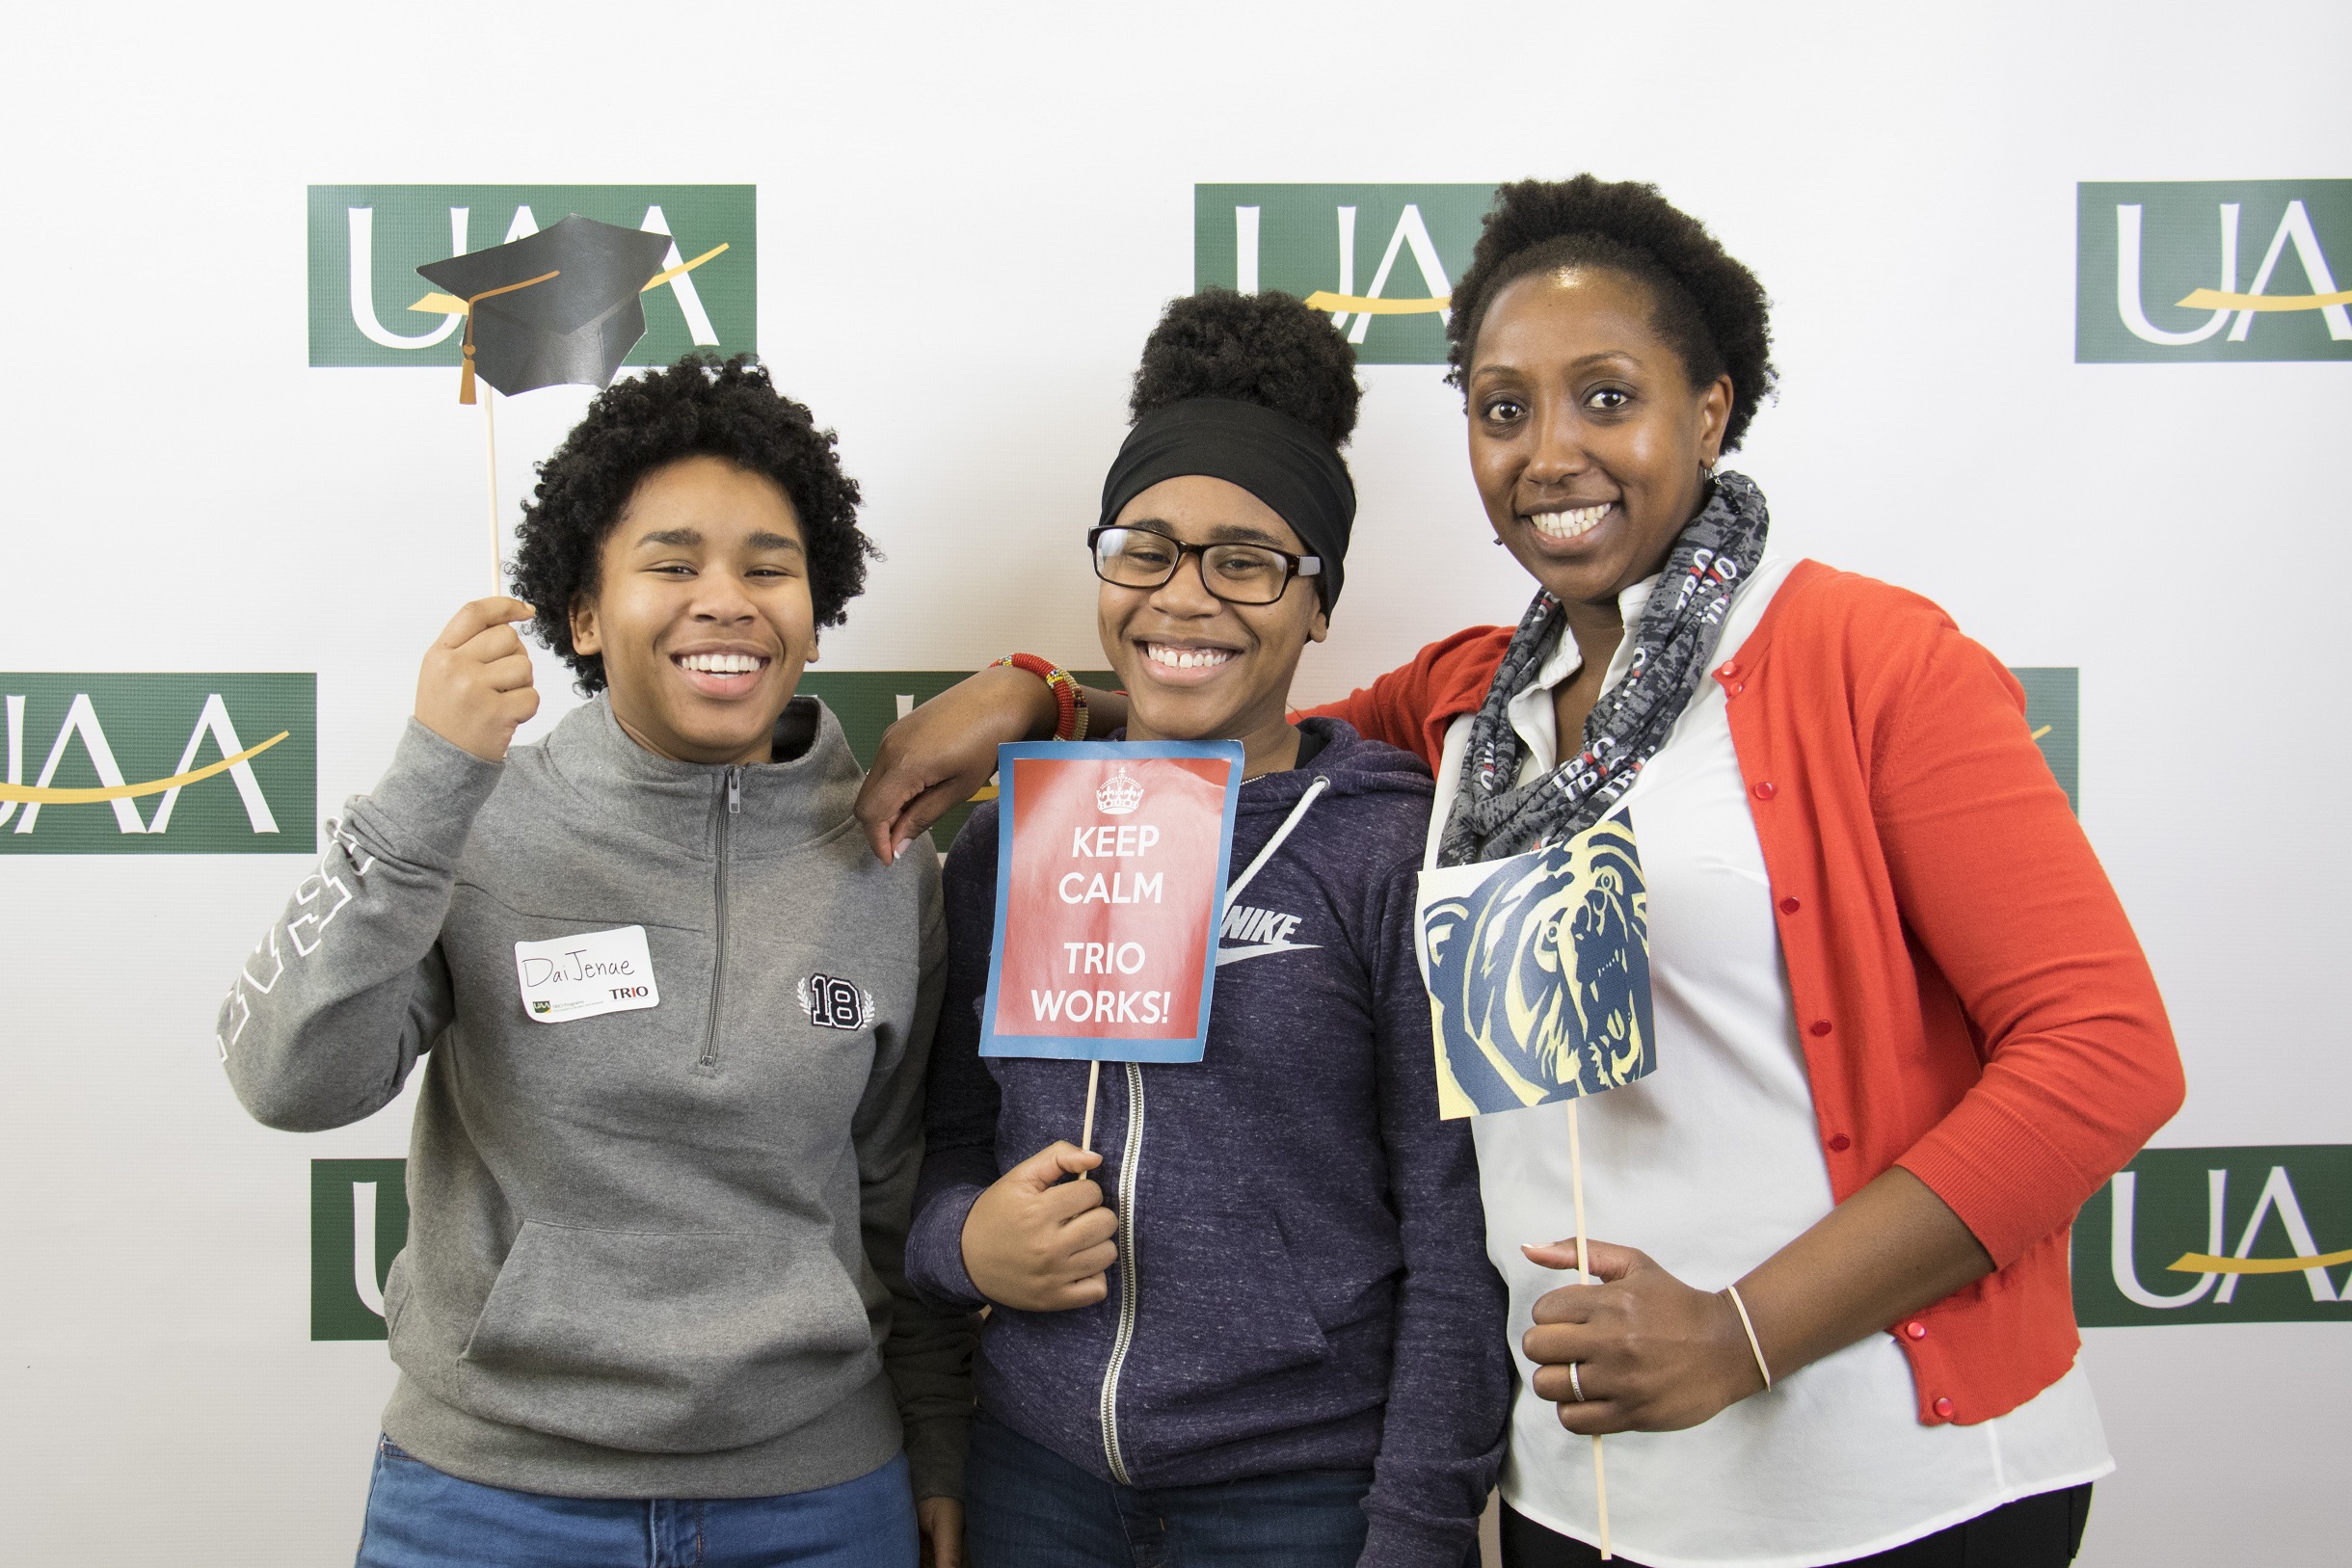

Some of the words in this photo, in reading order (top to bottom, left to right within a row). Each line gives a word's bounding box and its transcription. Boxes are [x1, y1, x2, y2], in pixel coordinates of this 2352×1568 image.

[348, 204, 720, 350] UA
[1071, 824, 1161, 859] KEEP
[1058, 871, 1164, 905] CALM
[1219, 905, 1302, 944] NIKE
[1063, 942, 1146, 975] TRIO
[609, 986, 649, 1000] TRIO
[810, 972, 864, 1031] 18
[1030, 988, 1171, 1024] WORKS!
[2111, 1166, 2352, 1309] UA
